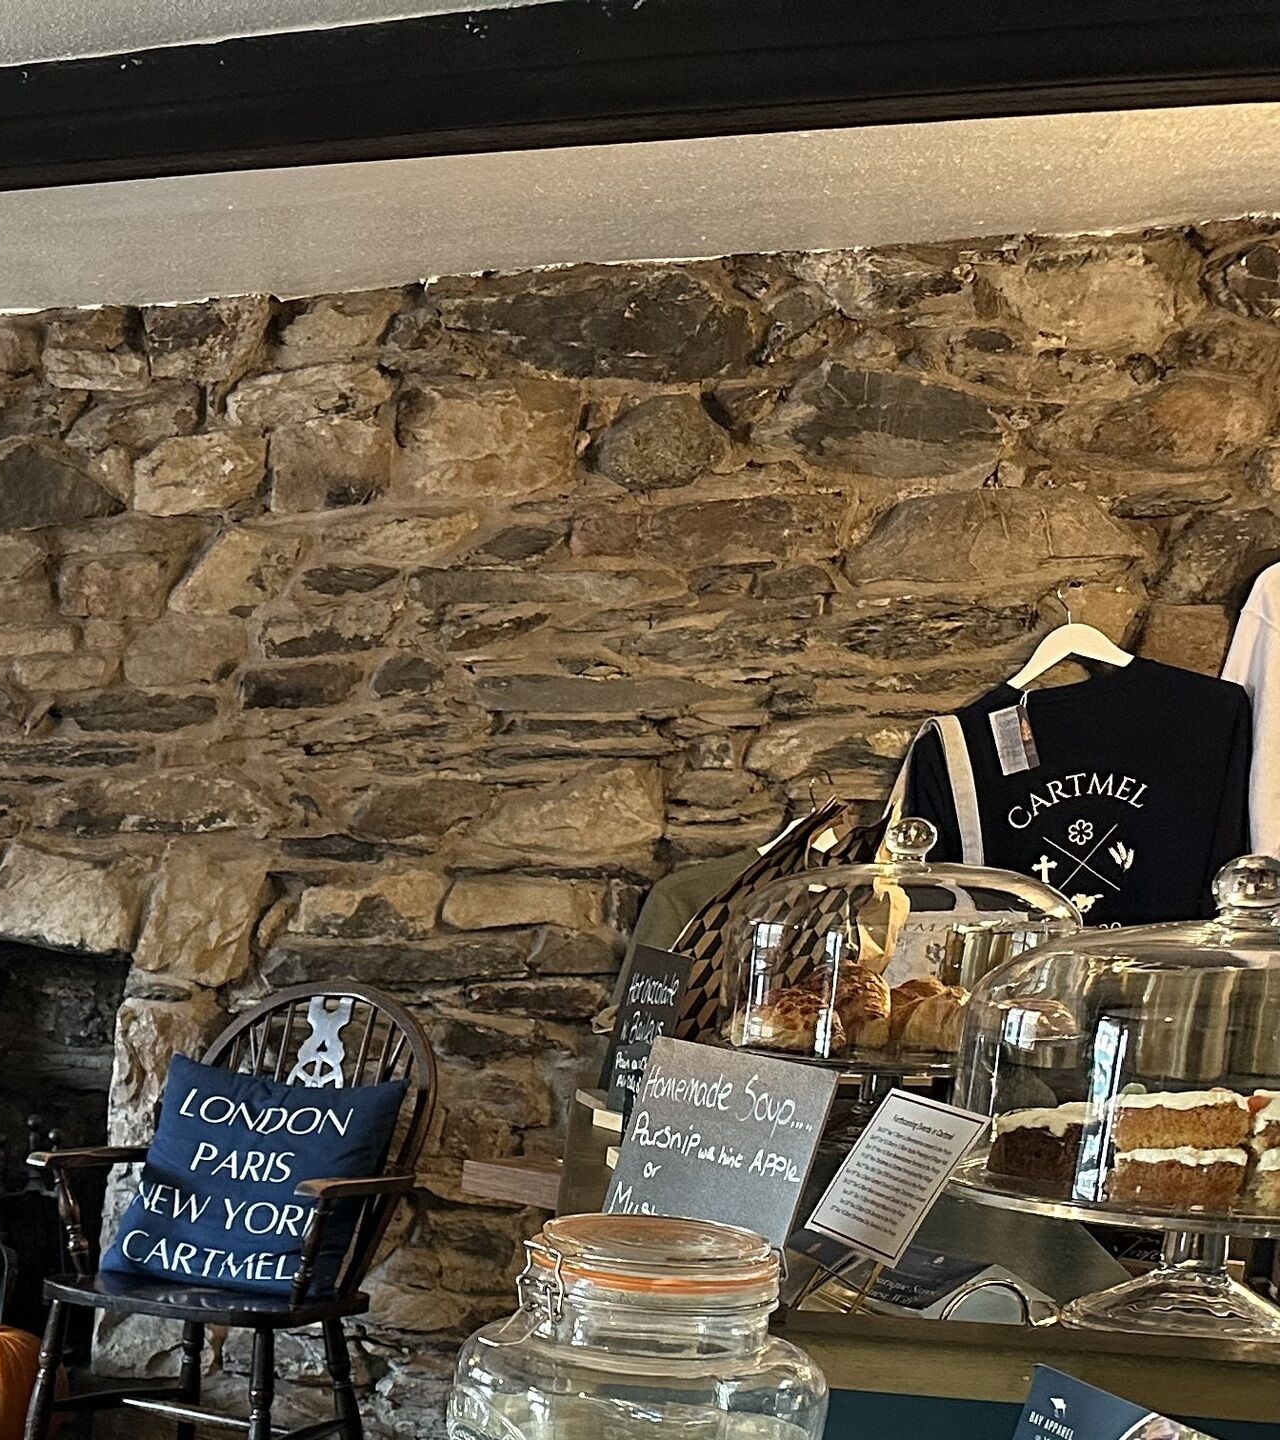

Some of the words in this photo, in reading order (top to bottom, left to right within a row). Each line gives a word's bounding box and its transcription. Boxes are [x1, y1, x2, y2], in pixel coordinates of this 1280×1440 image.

[1008, 773, 1149, 829] CARTMEL
[642, 1064, 733, 1111] Homemade
[179, 1088, 354, 1137] LONDON
[190, 1141, 295, 1183] PARIS
[643, 1162, 661, 1178] or
[132, 1181, 211, 1224] NEW
[122, 1230, 293, 1280] CARTMEL
[1028, 1411, 1044, 1426] BAY
